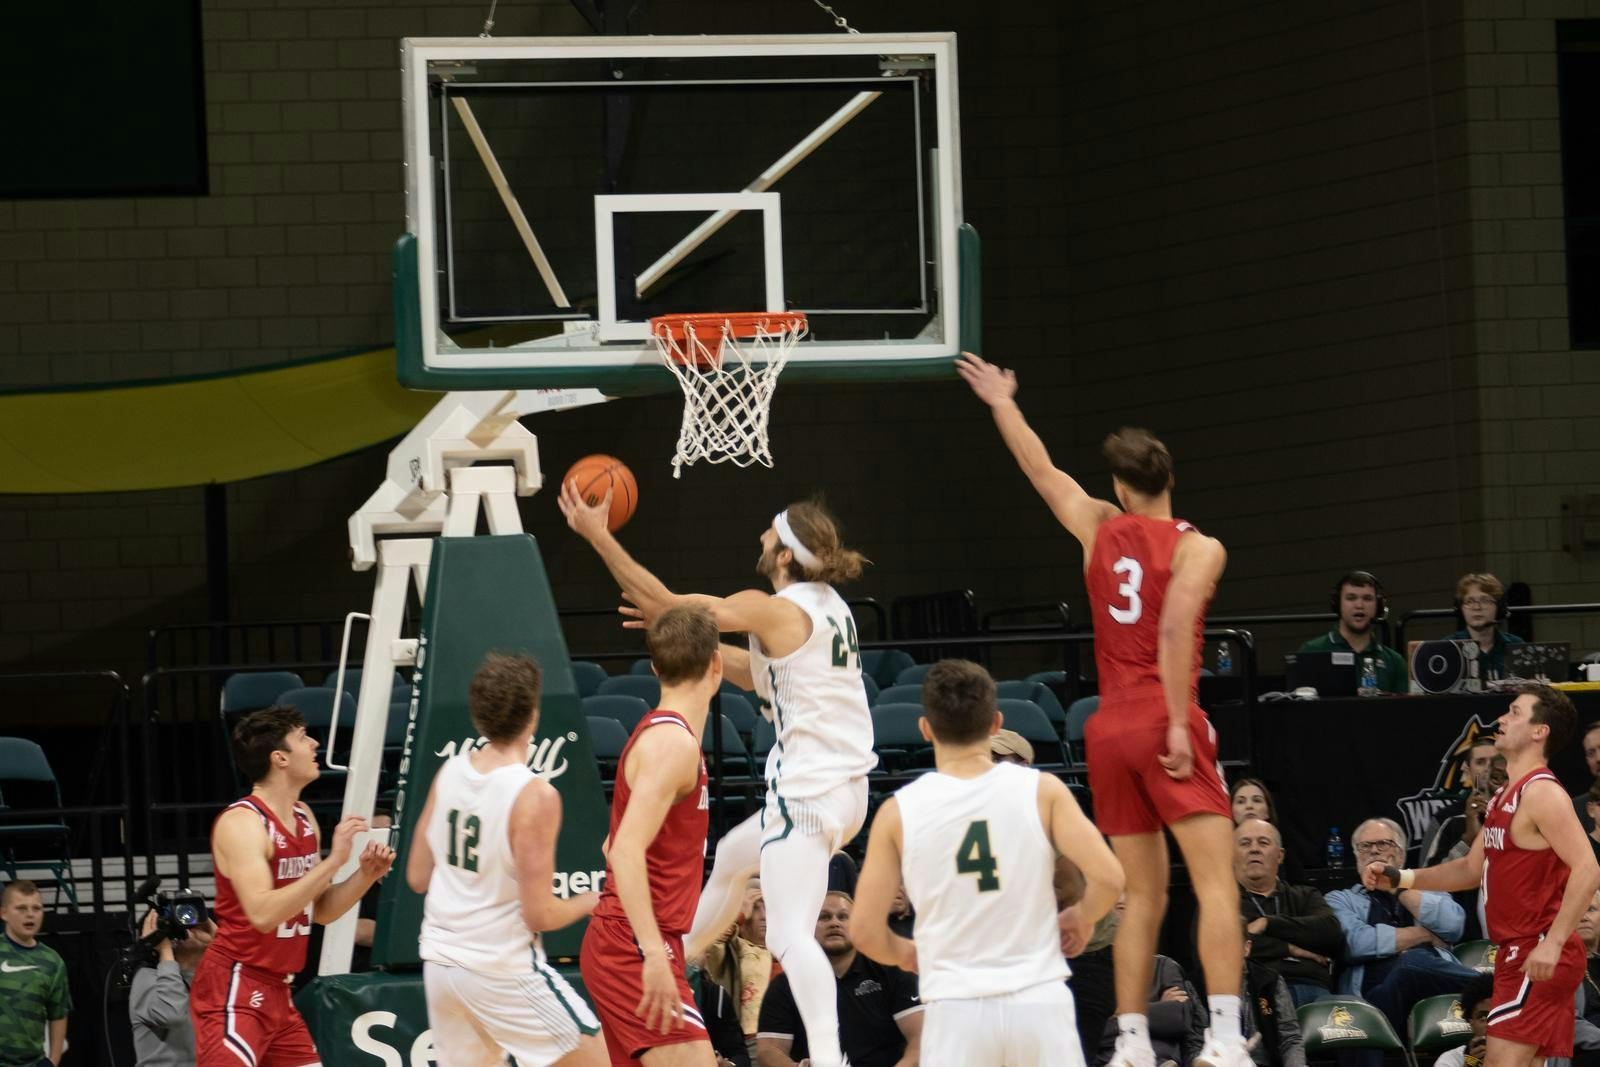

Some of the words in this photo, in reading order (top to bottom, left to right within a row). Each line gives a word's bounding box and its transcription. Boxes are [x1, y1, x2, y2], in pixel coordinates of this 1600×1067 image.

[1108, 556, 1144, 625] 3
[826, 615, 861, 669] 24
[446, 808, 481, 873] 12
[955, 818, 1001, 893] 4
